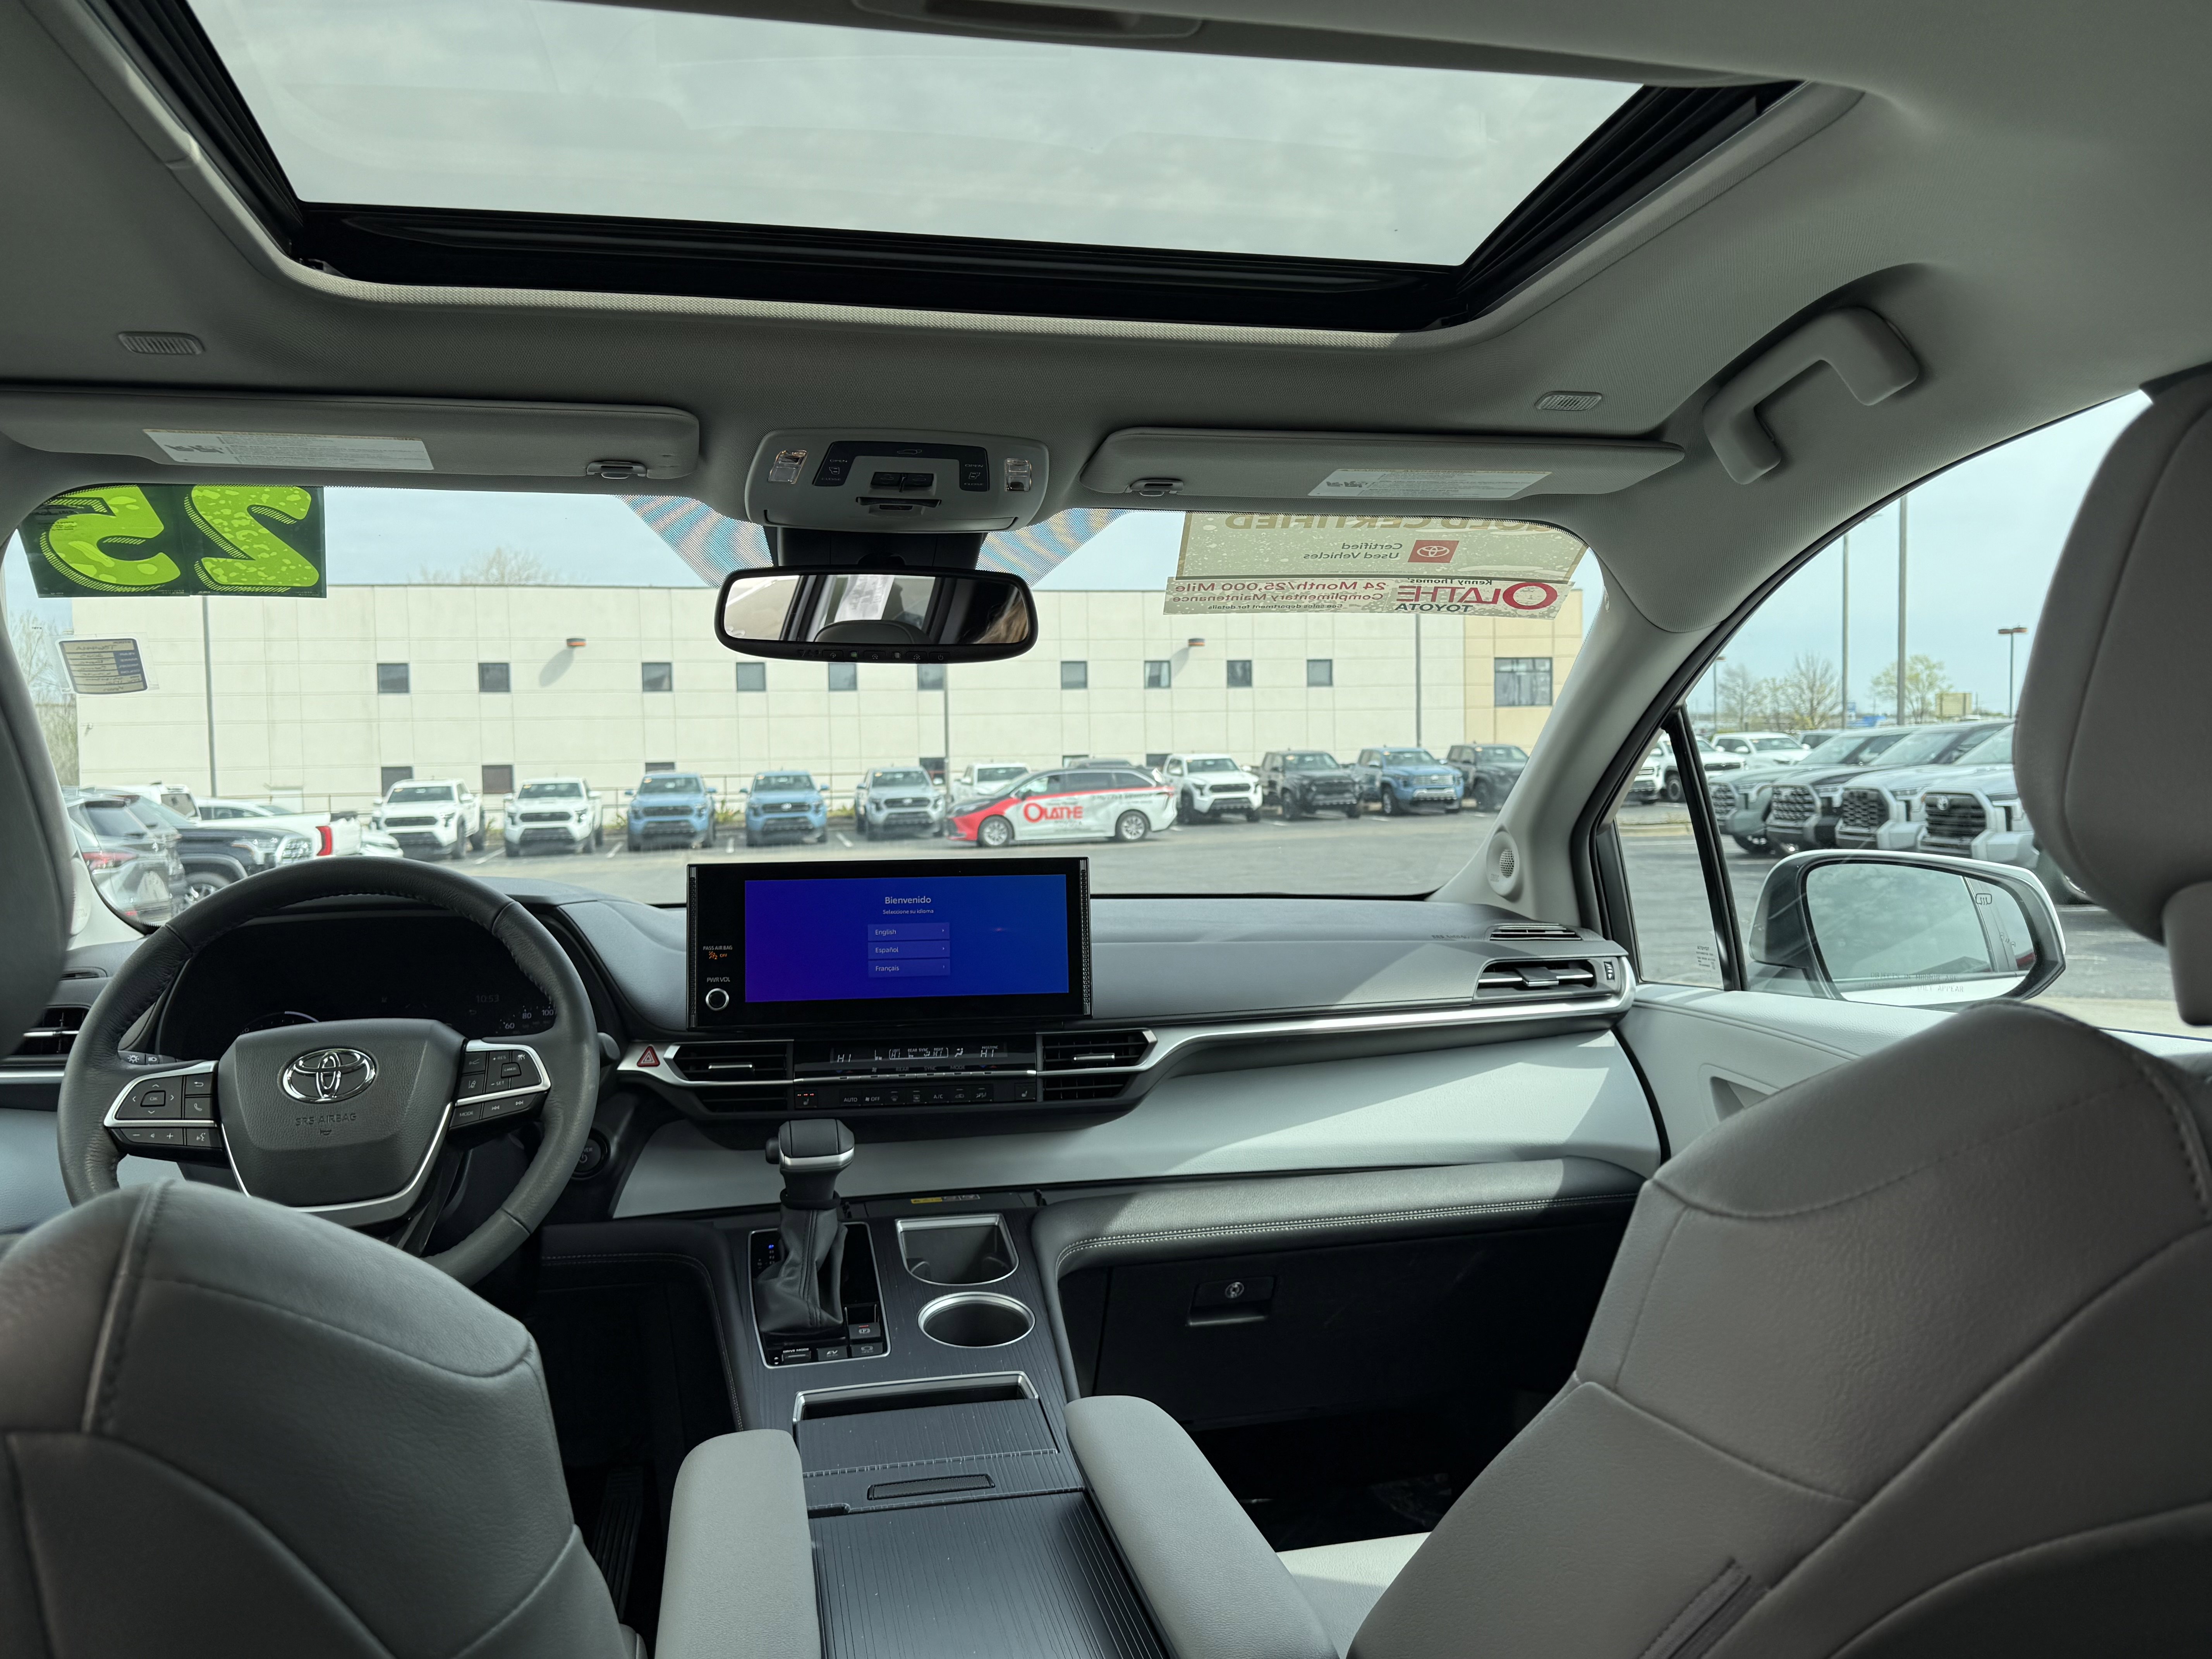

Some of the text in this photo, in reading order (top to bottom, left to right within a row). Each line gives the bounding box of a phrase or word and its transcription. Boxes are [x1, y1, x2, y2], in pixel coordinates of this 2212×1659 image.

[884, 896, 931, 904] Bienvenido
[475, 994, 500, 1003] 10:53
[295, 1113, 357, 1126] SRS AIRBAG
